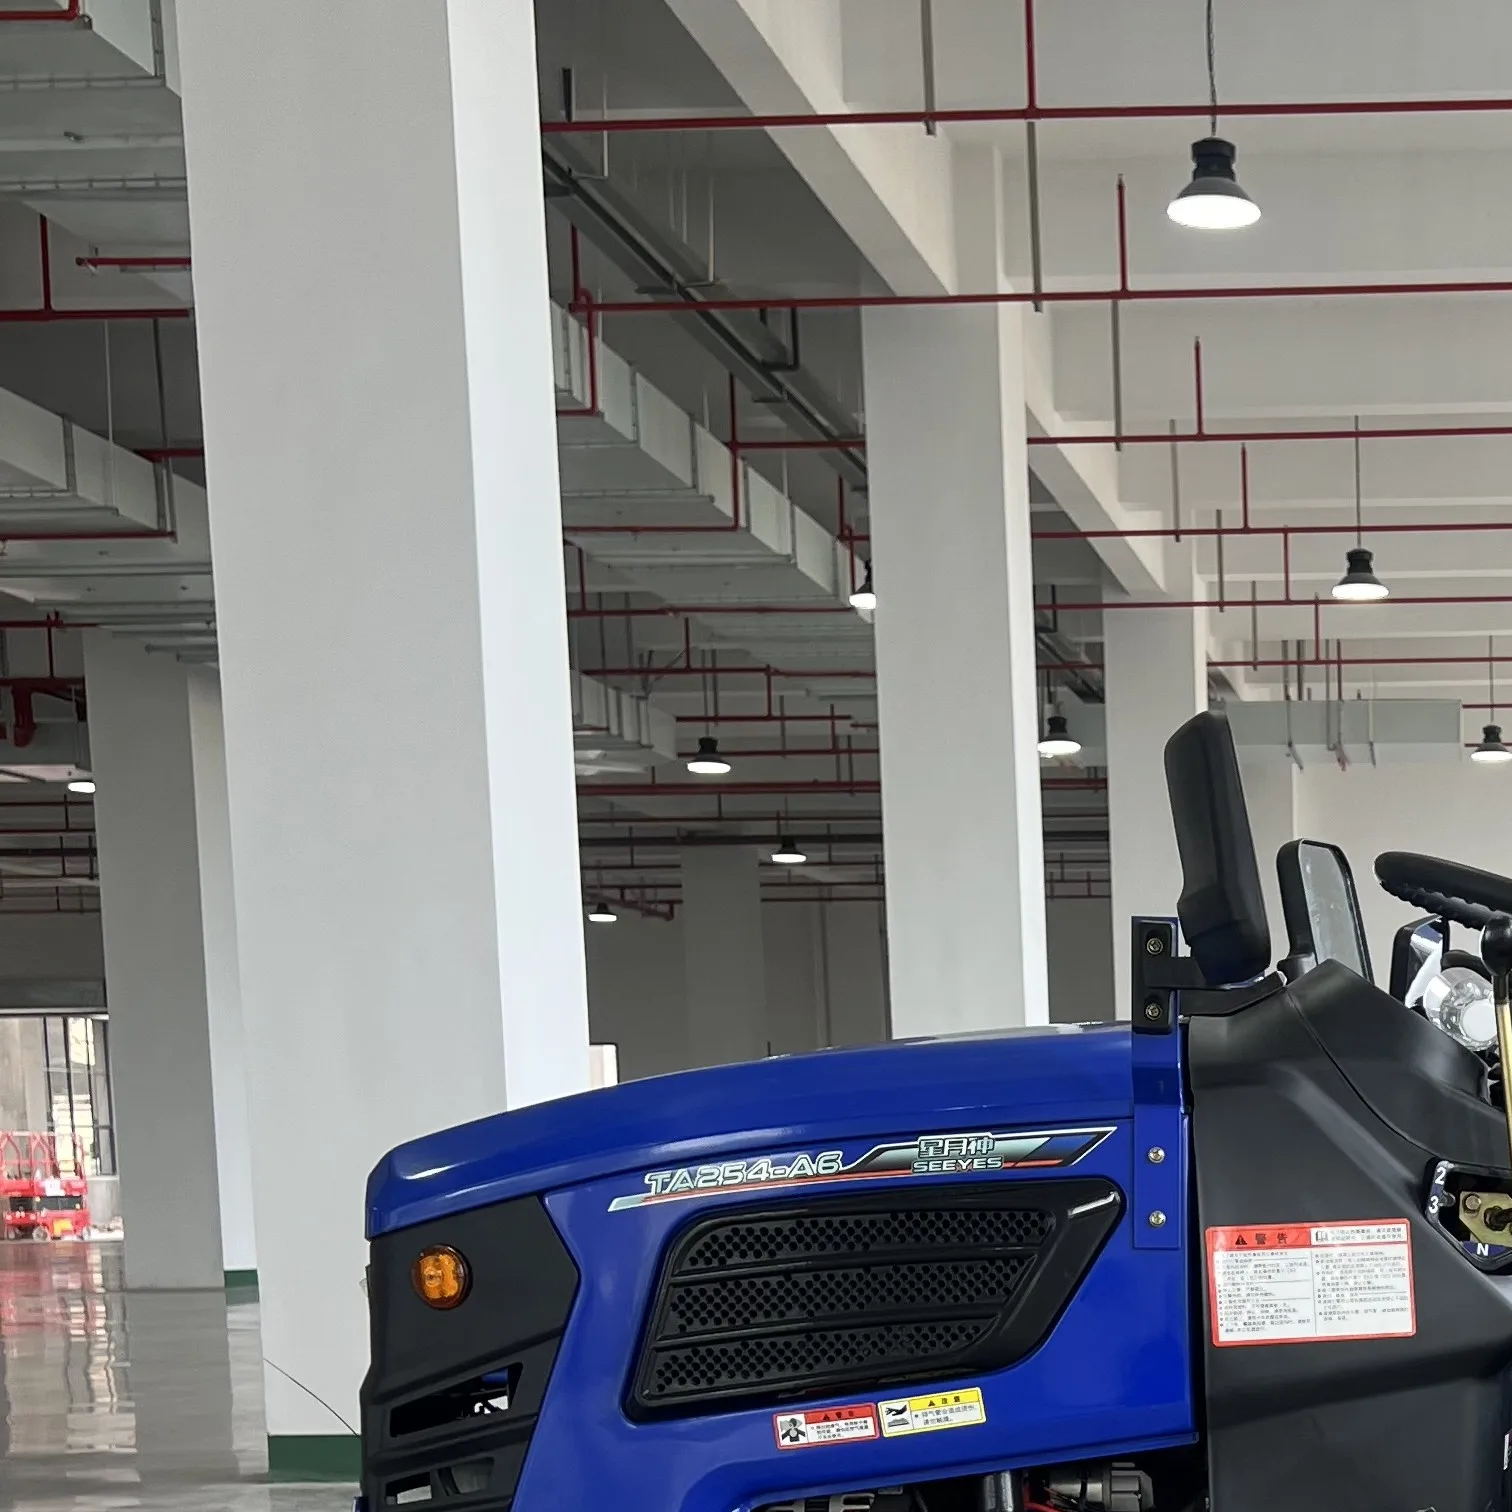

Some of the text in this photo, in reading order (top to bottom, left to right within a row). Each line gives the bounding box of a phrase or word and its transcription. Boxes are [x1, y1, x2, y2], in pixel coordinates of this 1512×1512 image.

[919, 1137, 995, 1159] 星月神
[645, 1151, 841, 1195] TA254-A6
[912, 1156, 1003, 1173] SEEYES
[1435, 1167, 1446, 1185] 2
[1428, 1196, 1440, 1214] 3
[1476, 1243, 1489, 1256] N
